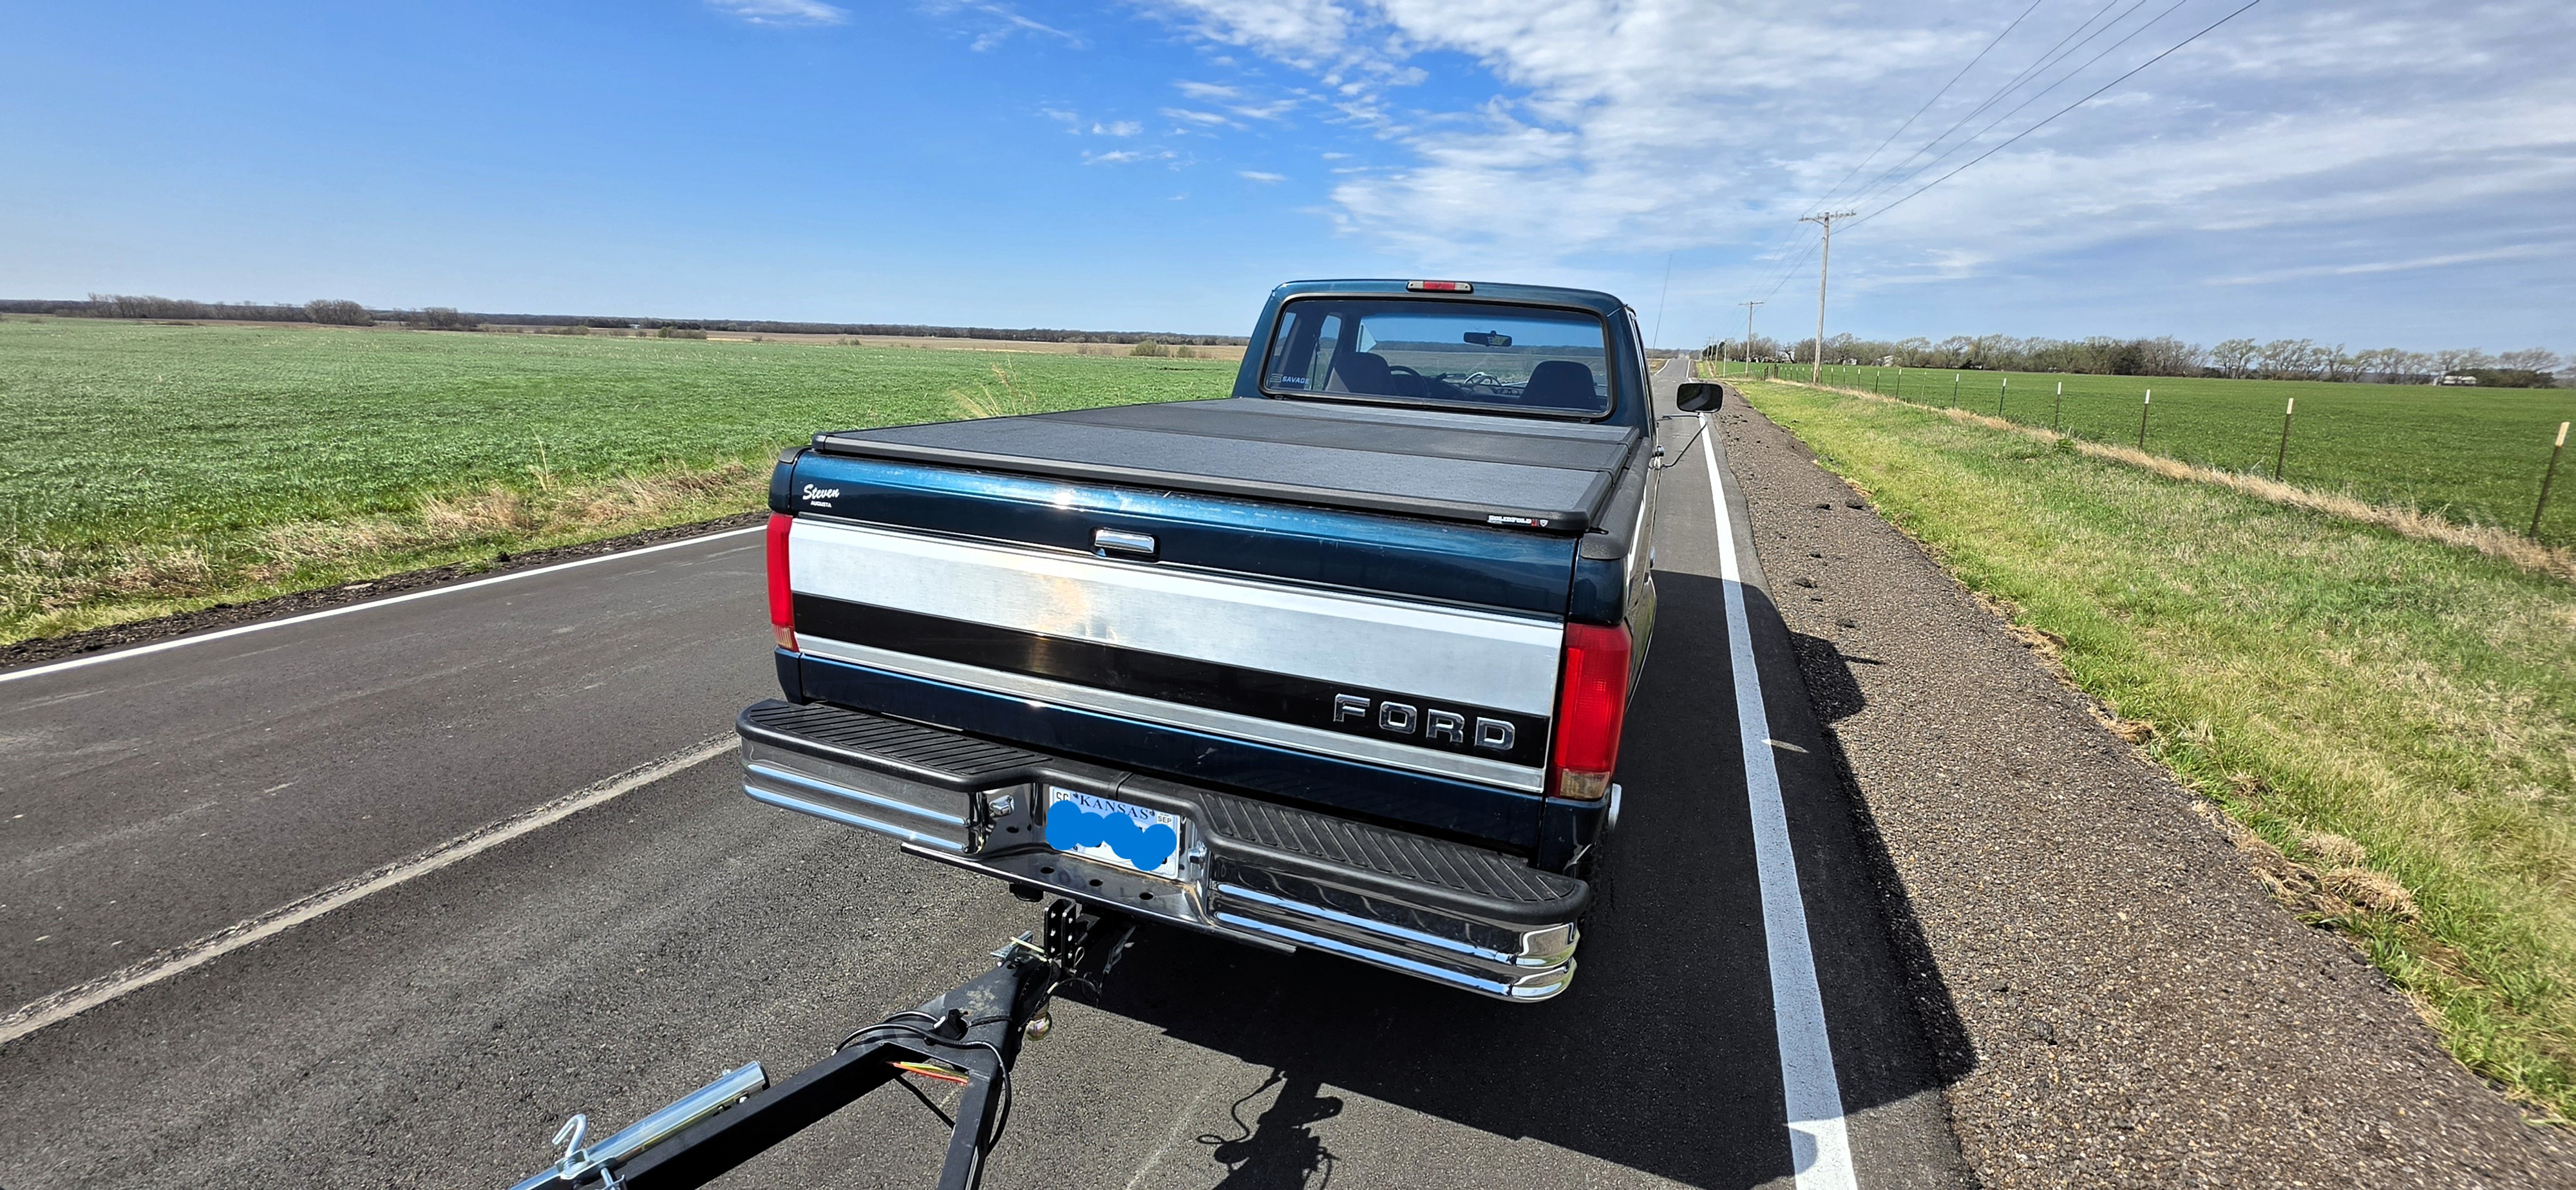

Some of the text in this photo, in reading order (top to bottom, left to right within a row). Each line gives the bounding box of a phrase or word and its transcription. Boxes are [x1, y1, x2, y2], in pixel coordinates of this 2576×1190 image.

[1282, 375, 1311, 384] SAVAGE
[802, 484, 840, 500] Steven
[1333, 694, 1515, 750] FORD
[1080, 795, 1150, 820] KANSAS
[1158, 815, 1172, 824] SEP
